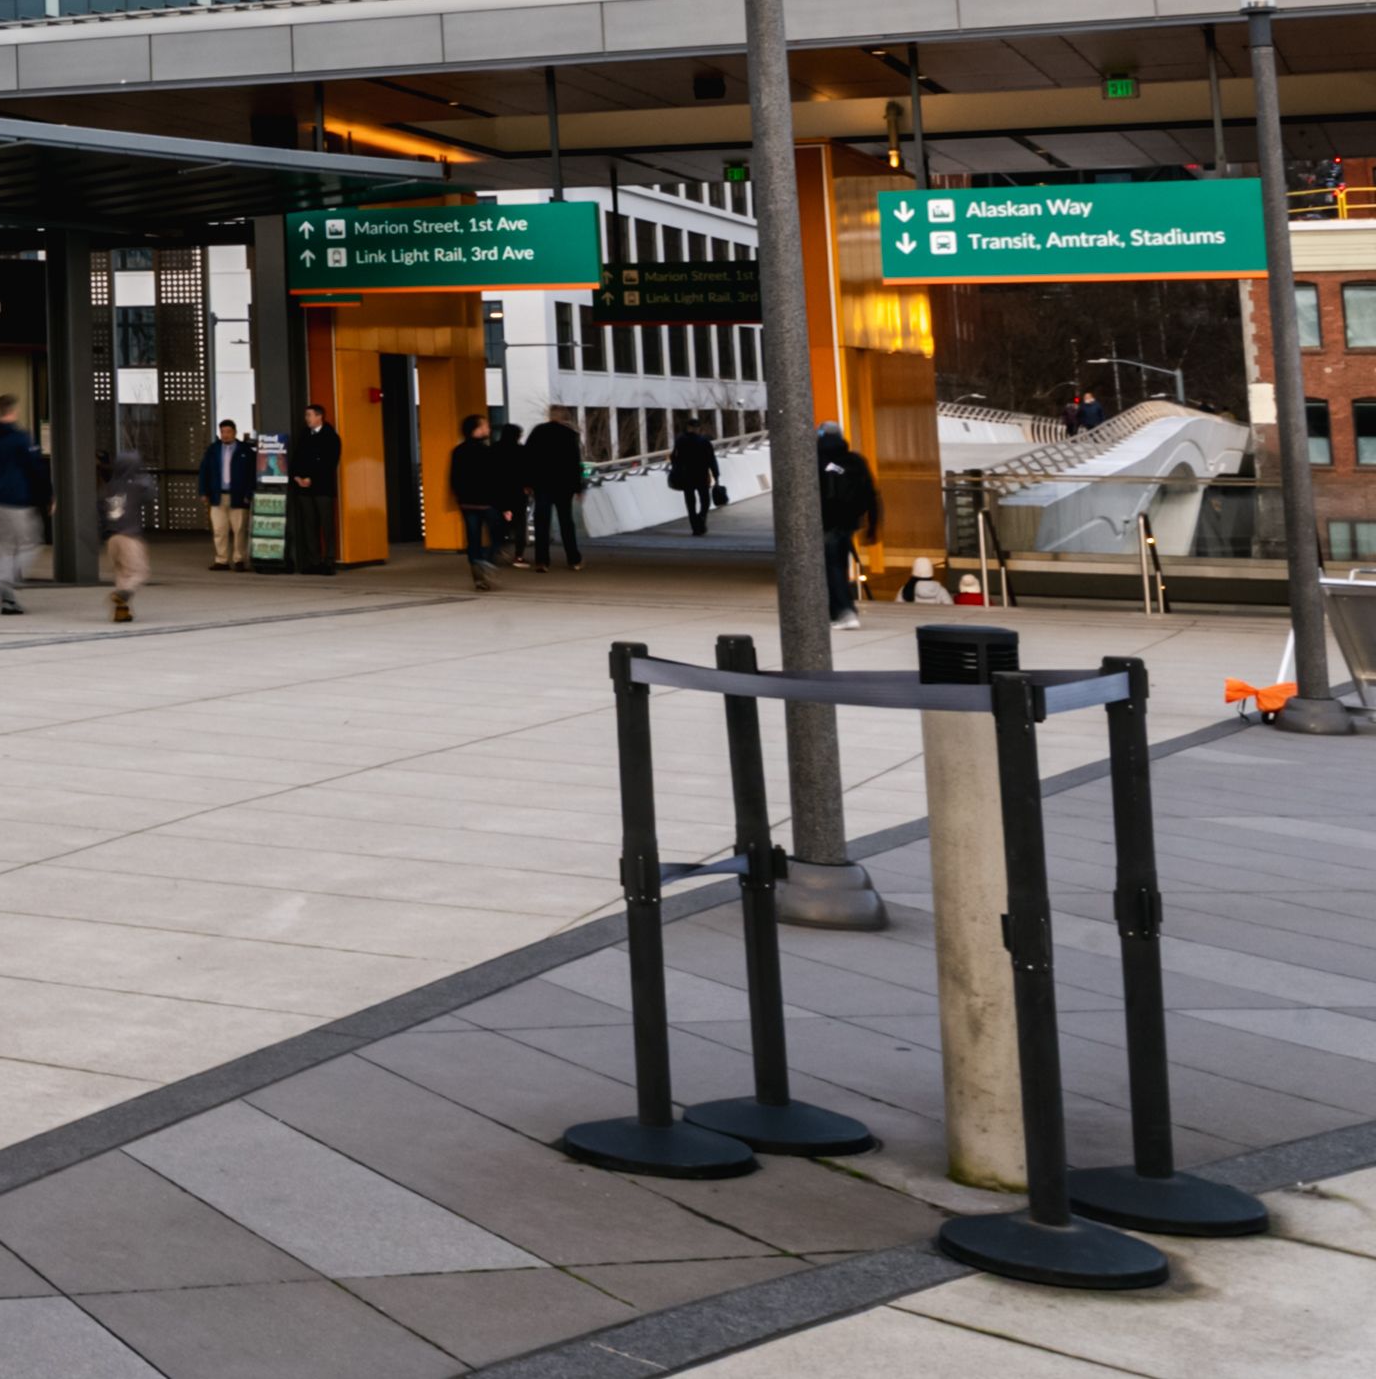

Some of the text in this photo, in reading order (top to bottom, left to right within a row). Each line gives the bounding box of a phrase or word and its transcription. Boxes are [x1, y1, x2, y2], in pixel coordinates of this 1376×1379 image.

[966, 198, 1093, 218] Alaskan Way
[354, 217, 528, 235] Marion Street, 1st Ave
[967, 228, 1226, 250] Transit, Amtrak, Stadiums
[355, 246, 535, 266] Link Light Rail, 3rd Ave
[645, 271, 688, 282] Marion
[645, 293, 670, 304] Link
[674, 291, 704, 305] Light
